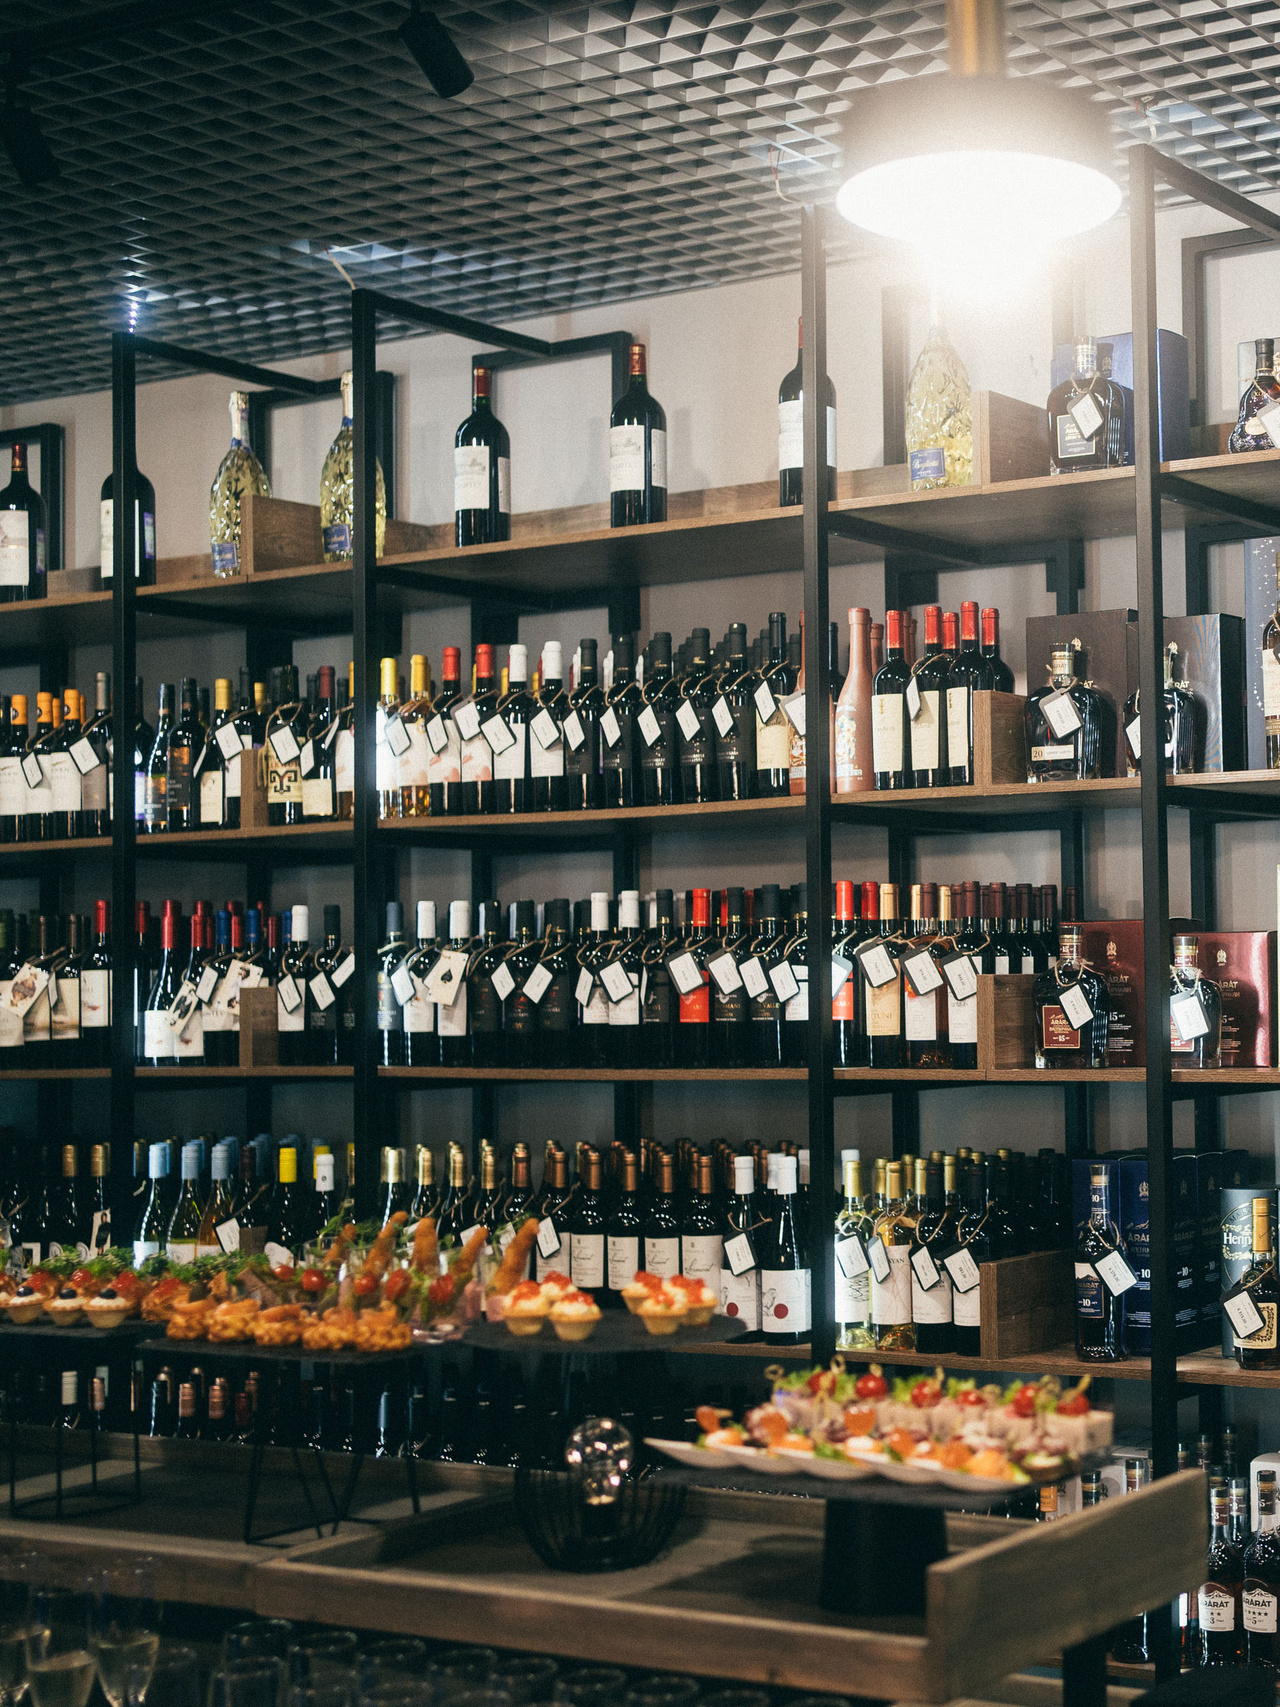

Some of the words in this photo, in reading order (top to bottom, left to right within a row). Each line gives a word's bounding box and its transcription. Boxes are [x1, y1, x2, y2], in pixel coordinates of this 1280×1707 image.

[1032, 749, 1043, 758] 20
[1223, 1232, 1252, 1245] Henn
[1141, 1269, 1151, 1278] 10
[1182, 1267, 1189, 1276] 10
[1082, 1298, 1091, 1307] 10
[1209, 1617, 1215, 1625] 3
[1251, 1616, 1257, 1625] 5
